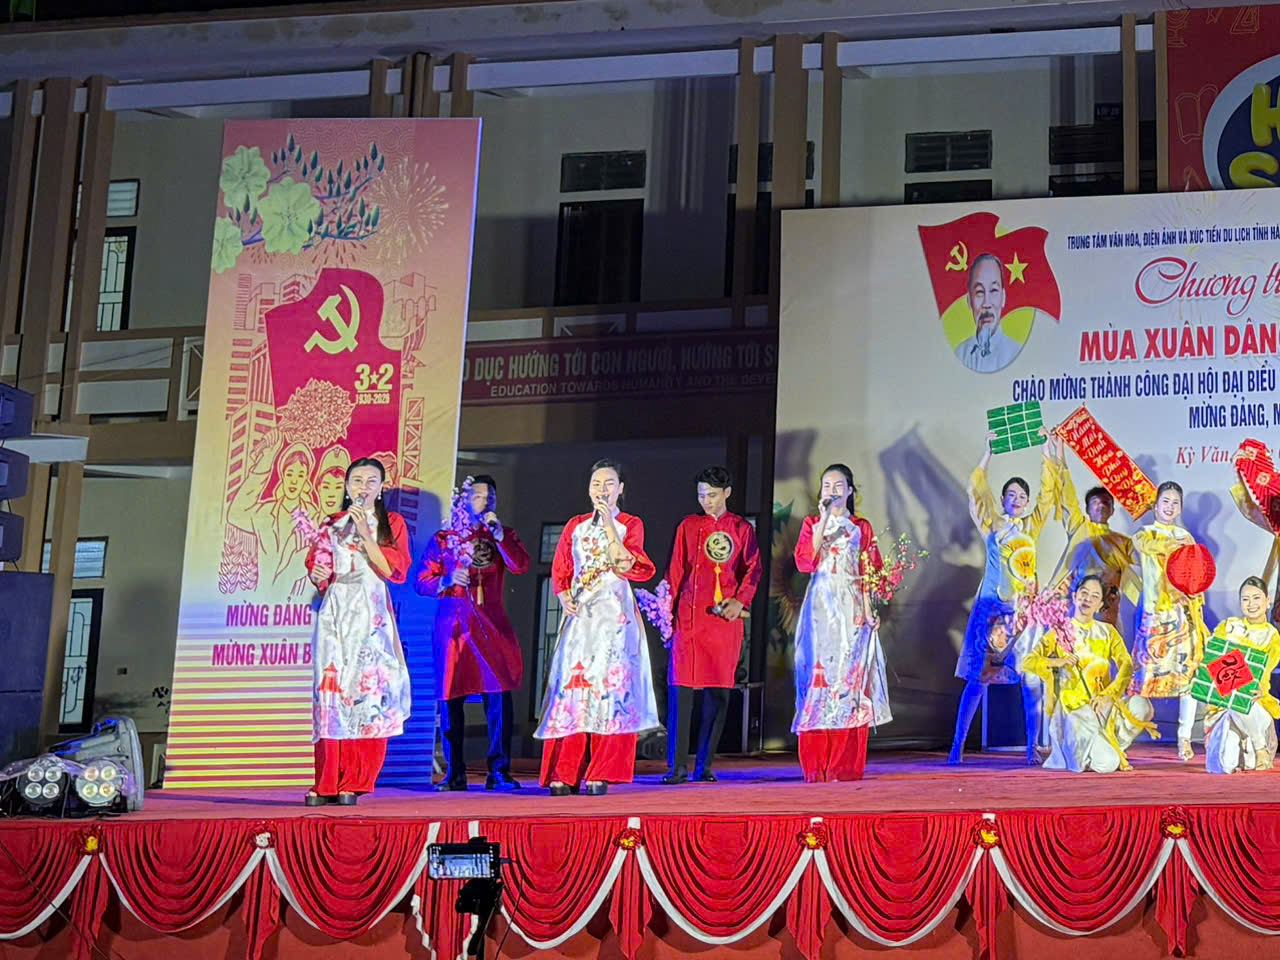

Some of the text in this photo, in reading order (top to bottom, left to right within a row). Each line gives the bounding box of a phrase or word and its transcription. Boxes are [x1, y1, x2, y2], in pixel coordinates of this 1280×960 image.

[1135, 256, 1257, 316] Chương
[1080, 323, 1136, 362] MÙA
[1144, 319, 1214, 358] XUÂN
[490, 382, 558, 397] EDUCATION
[1013, 374, 1045, 402] CHÀO
[1050, 373, 1086, 401] MỪNG
[1090, 370, 1131, 398] THÀNH
[1135, 369, 1169, 396] CÔNG
[1173, 372, 1193, 400] ĐẠI
[1198, 366, 1219, 399] HỘI
[1222, 370, 1243, 398] ĐẠI
[1247, 360, 1276, 391] BIỂU
[1189, 401, 1226, 429] MỪNG
[1230, 399, 1269, 429] ĐẢNG,
[1176, 446, 1195, 468] Kỳ
[226, 596, 312, 627] MỪNG ĐẢNG
[212, 639, 256, 666] MỪNG
[260, 638, 299, 665] XUÂN
